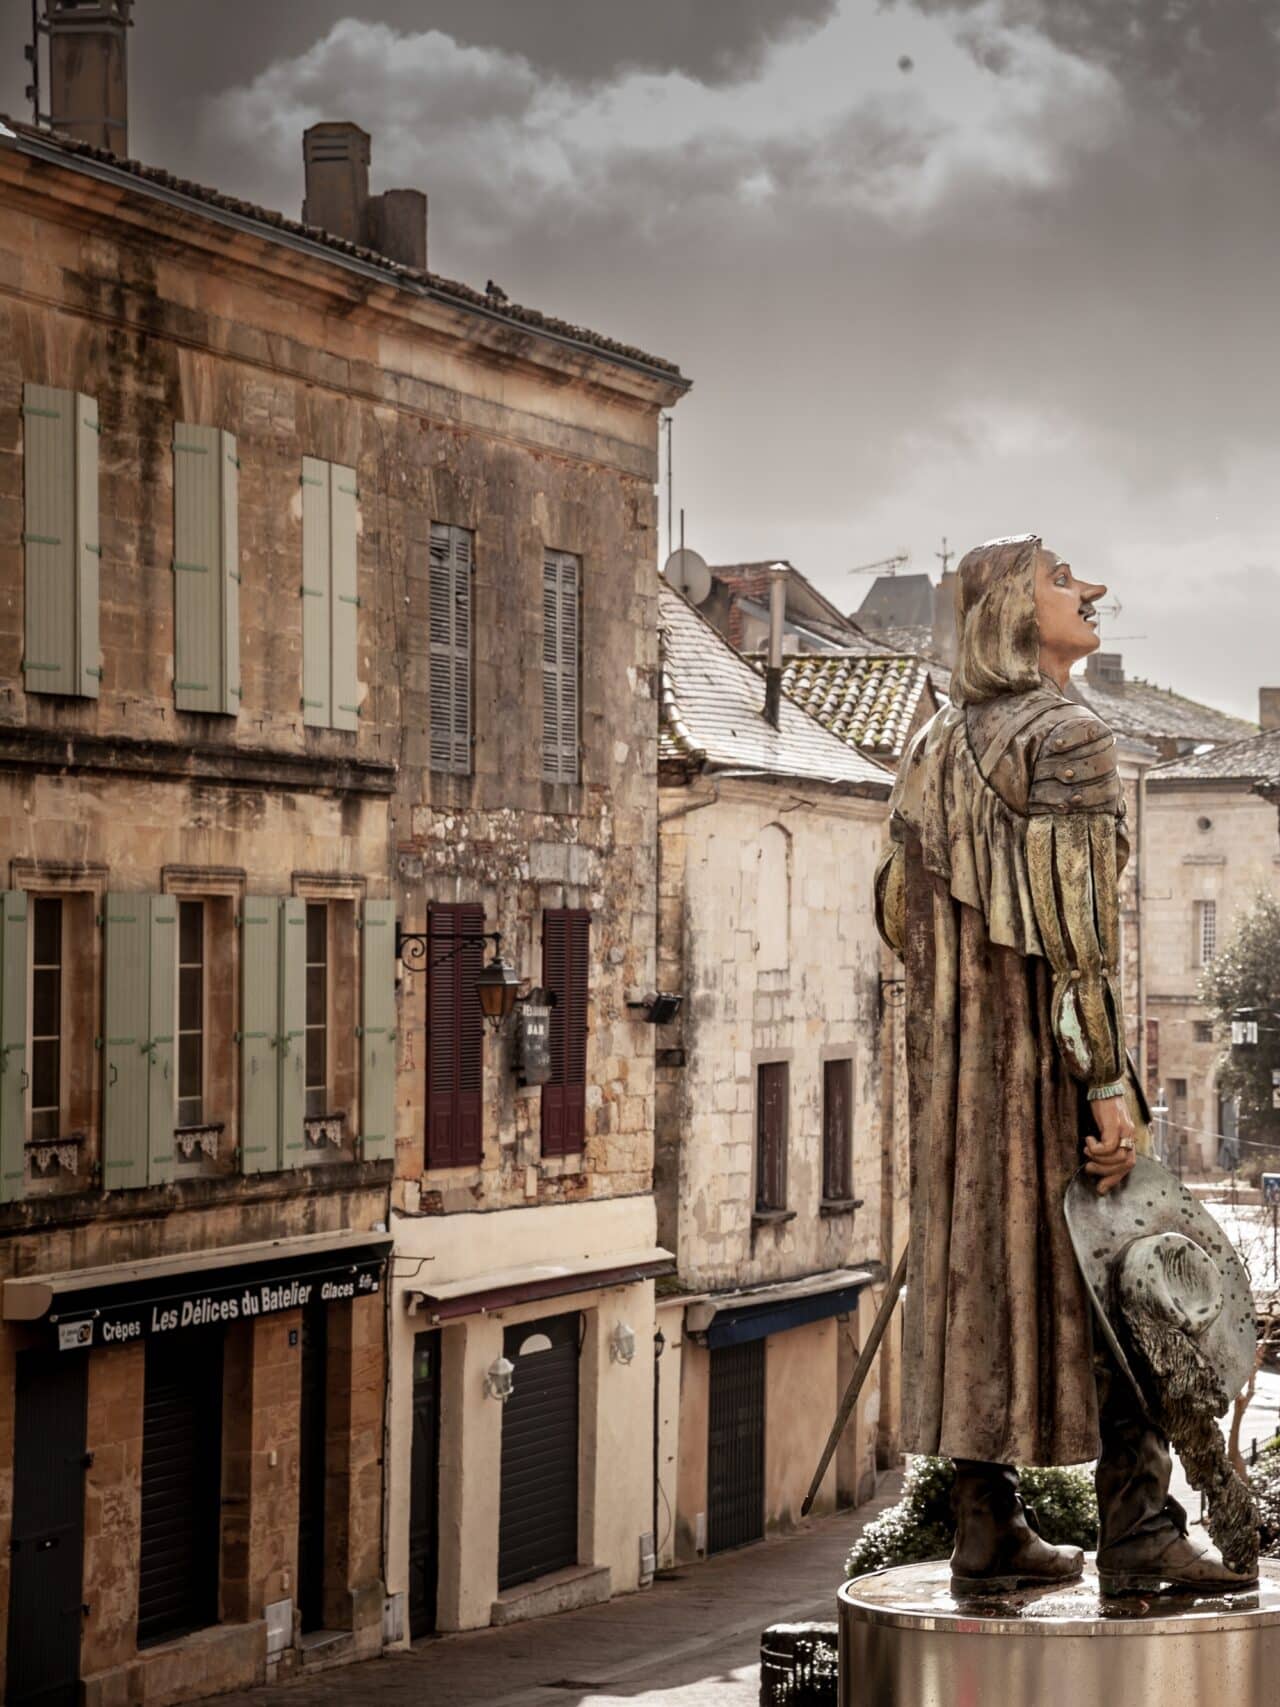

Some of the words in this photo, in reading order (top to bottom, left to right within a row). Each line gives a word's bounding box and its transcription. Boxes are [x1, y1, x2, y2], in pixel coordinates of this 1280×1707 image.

[527, 1023, 545, 1036] BAR
[102, 1320, 141, 1342] Crêpes
[151, 1306, 179, 1333] Les
[180, 1297, 239, 1328] Délices
[241, 1289, 260, 1316] du
[261, 1281, 312, 1312] Batelier
[321, 1281, 354, 1299] Glaces
